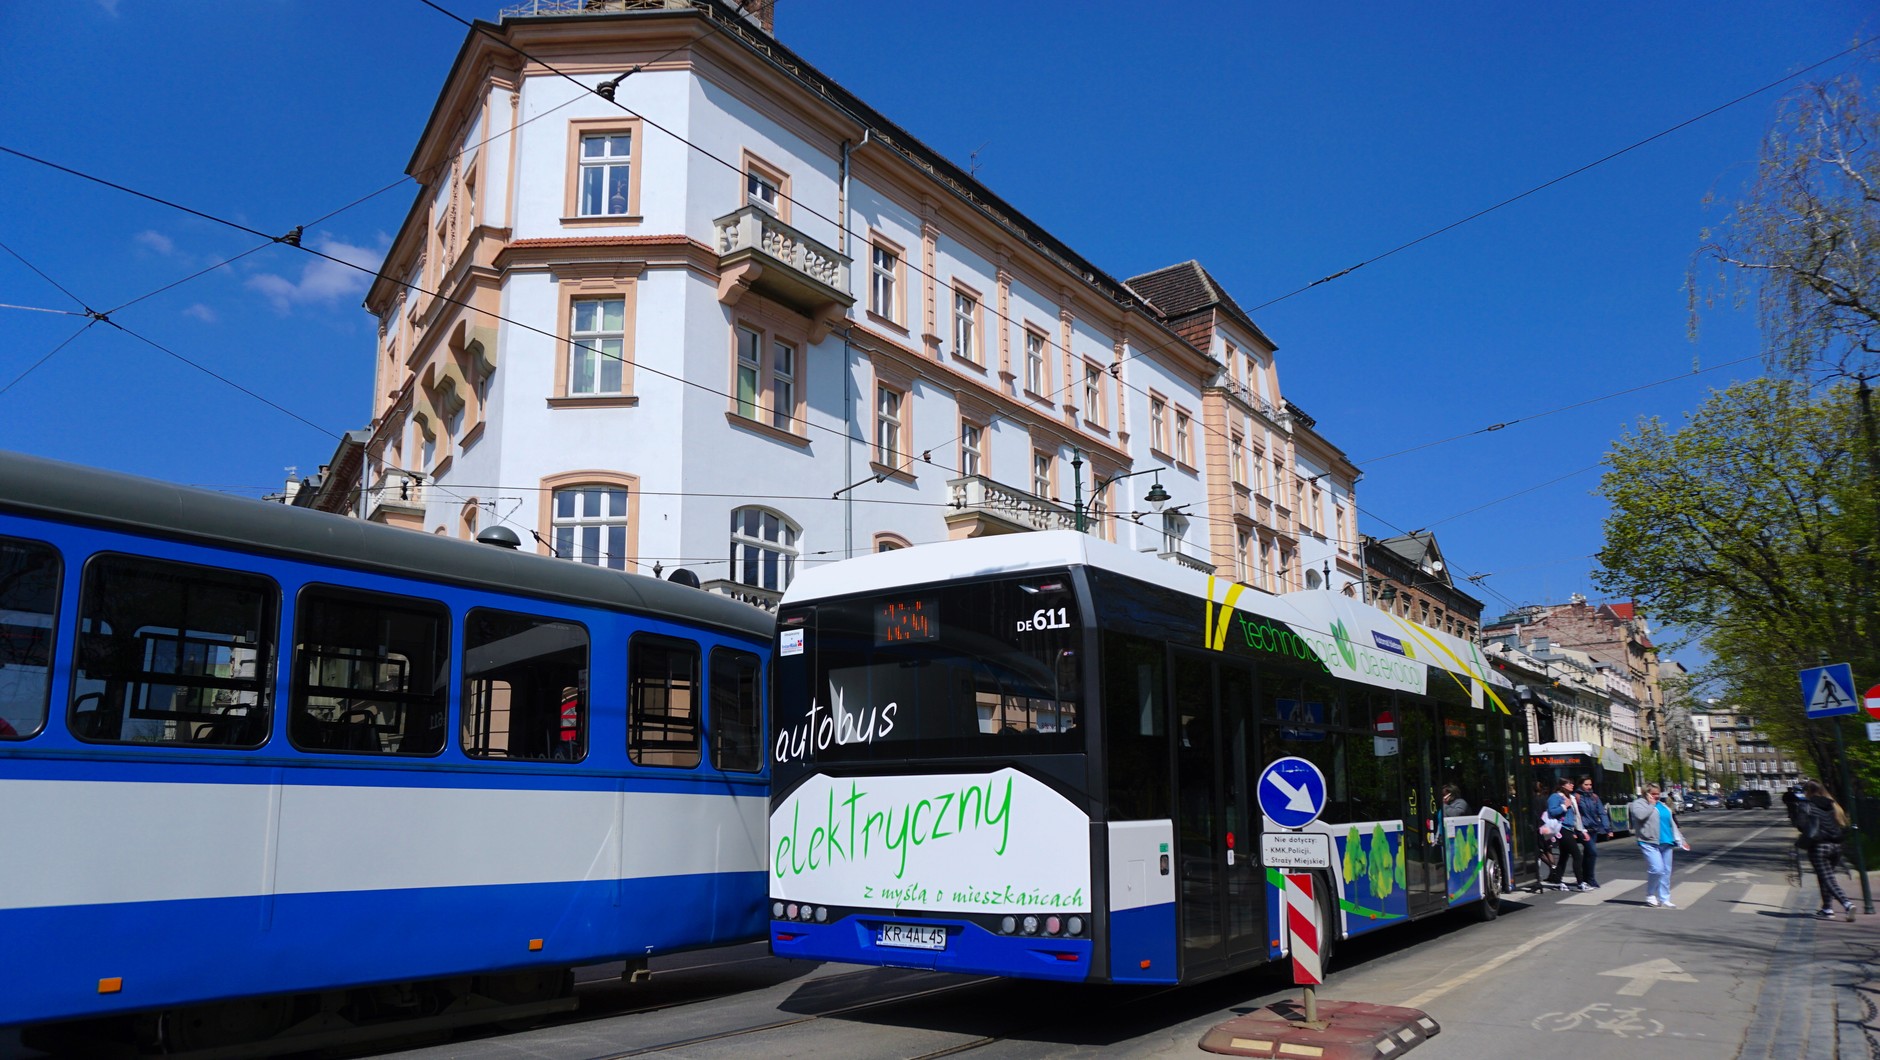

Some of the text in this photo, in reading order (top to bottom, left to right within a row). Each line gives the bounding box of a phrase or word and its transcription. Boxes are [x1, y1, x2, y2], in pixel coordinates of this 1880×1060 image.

[1238, 612, 1343, 673] technologia
[775, 686, 898, 763] autobus
[775, 775, 1013, 880] elektryczny
[1294, 857, 1326, 865] Miejskiej
[863, 883, 1085, 908] z myślą o mieszkańcach
[884, 925, 902, 941] KR
